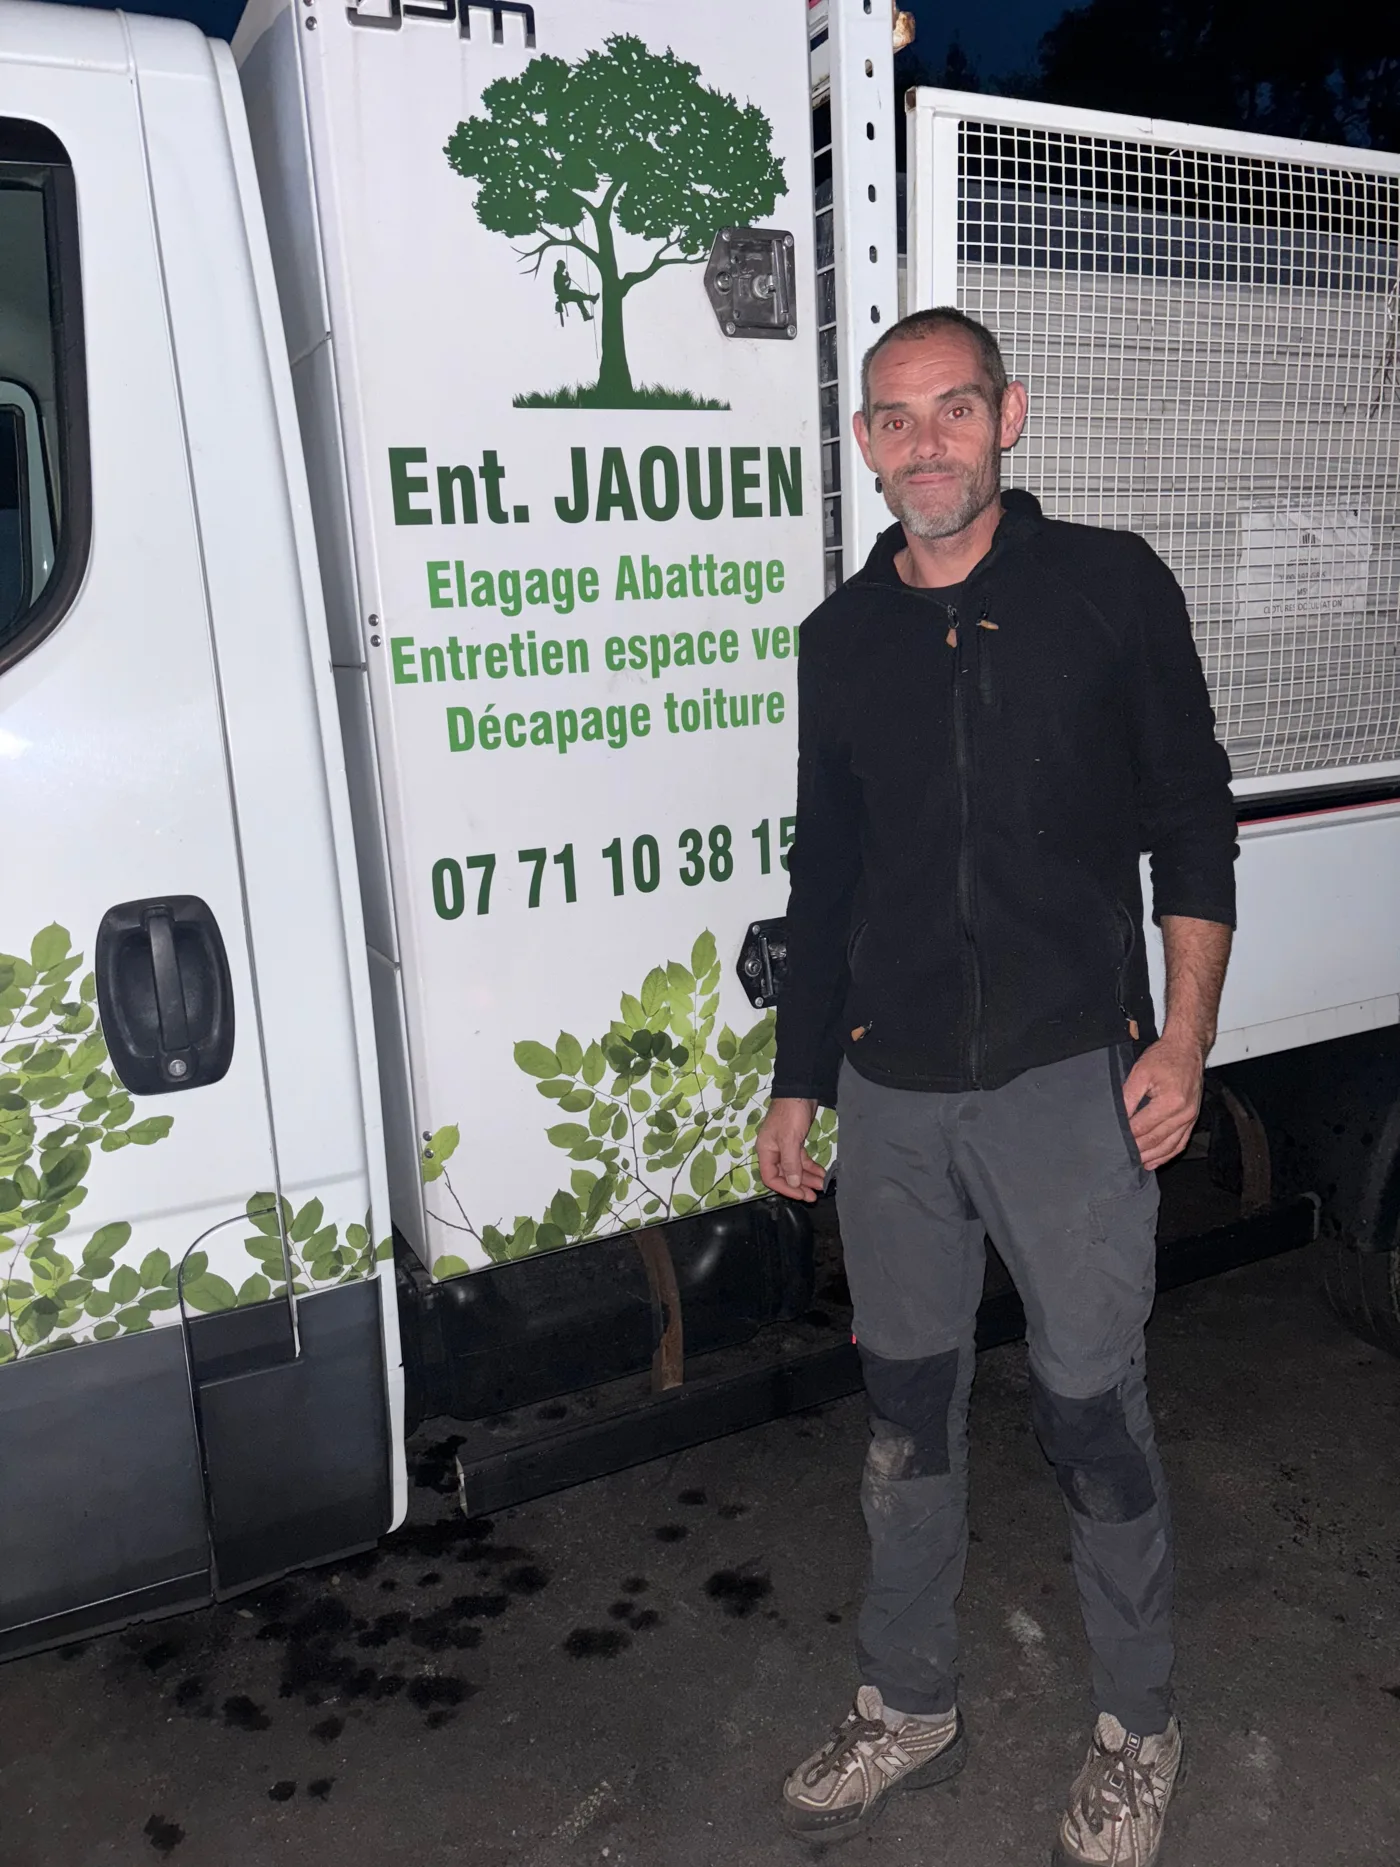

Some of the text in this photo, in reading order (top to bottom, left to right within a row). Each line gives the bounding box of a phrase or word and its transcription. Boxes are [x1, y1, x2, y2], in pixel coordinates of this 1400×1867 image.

[388, 445, 803, 526] Ent. JAOUEN
[426, 553, 786, 617] Elagage Abattage
[390, 625, 800, 685] Entretien espace ver
[446, 688, 786, 755] Décapage toiture
[431, 853, 496, 921] 07
[518, 843, 578, 909] 71
[602, 834, 661, 897] 10
[678, 824, 734, 887] 38
